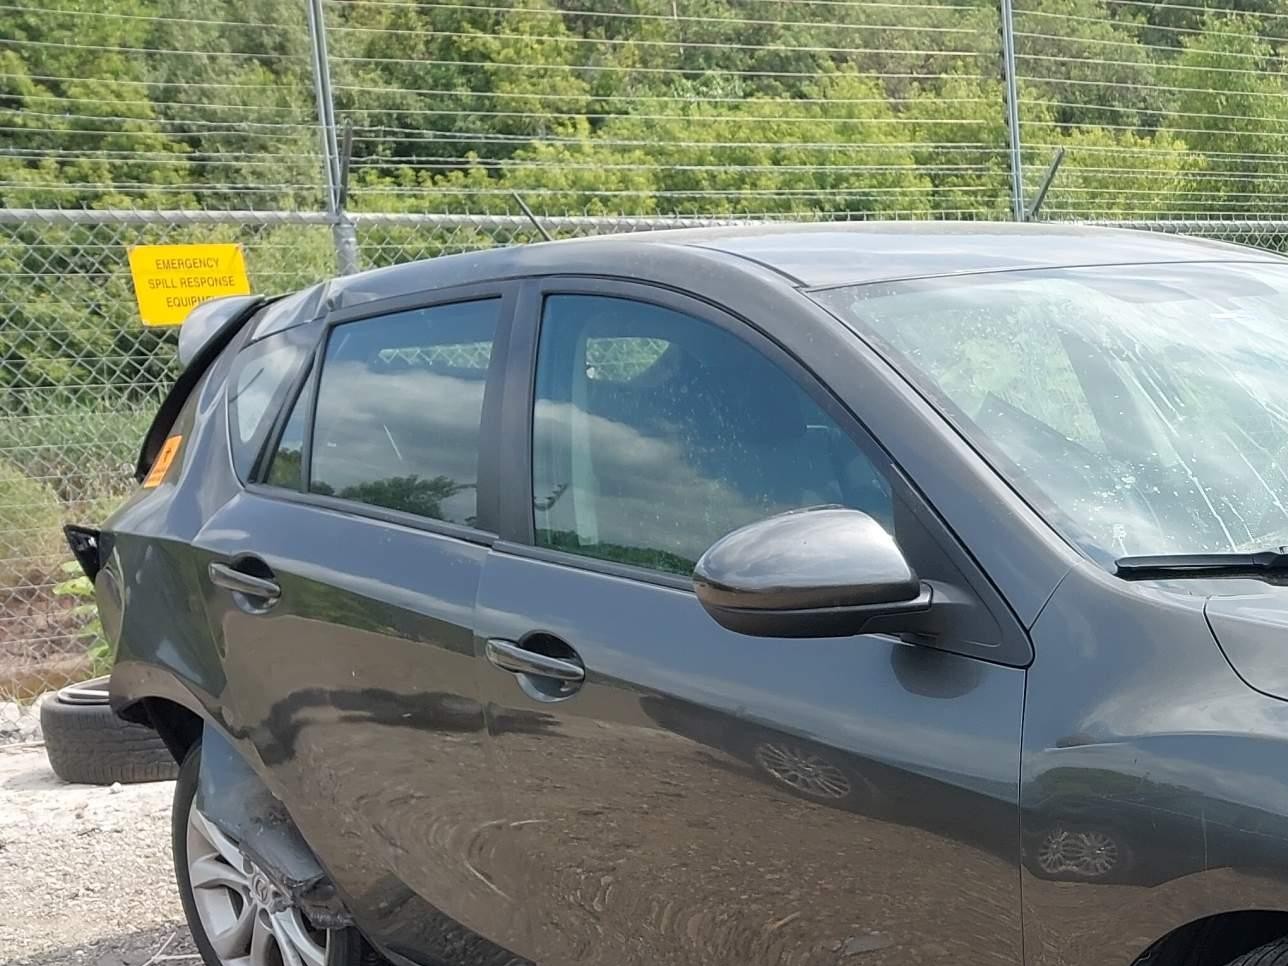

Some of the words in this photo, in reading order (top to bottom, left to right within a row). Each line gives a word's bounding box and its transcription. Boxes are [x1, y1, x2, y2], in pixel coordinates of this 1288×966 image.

[155, 257, 219, 270] EMERGENCY
[147, 278, 177, 289] SPILL
[180, 275, 236, 288] RESPONSE
[166, 295, 215, 307] EQUIPM
